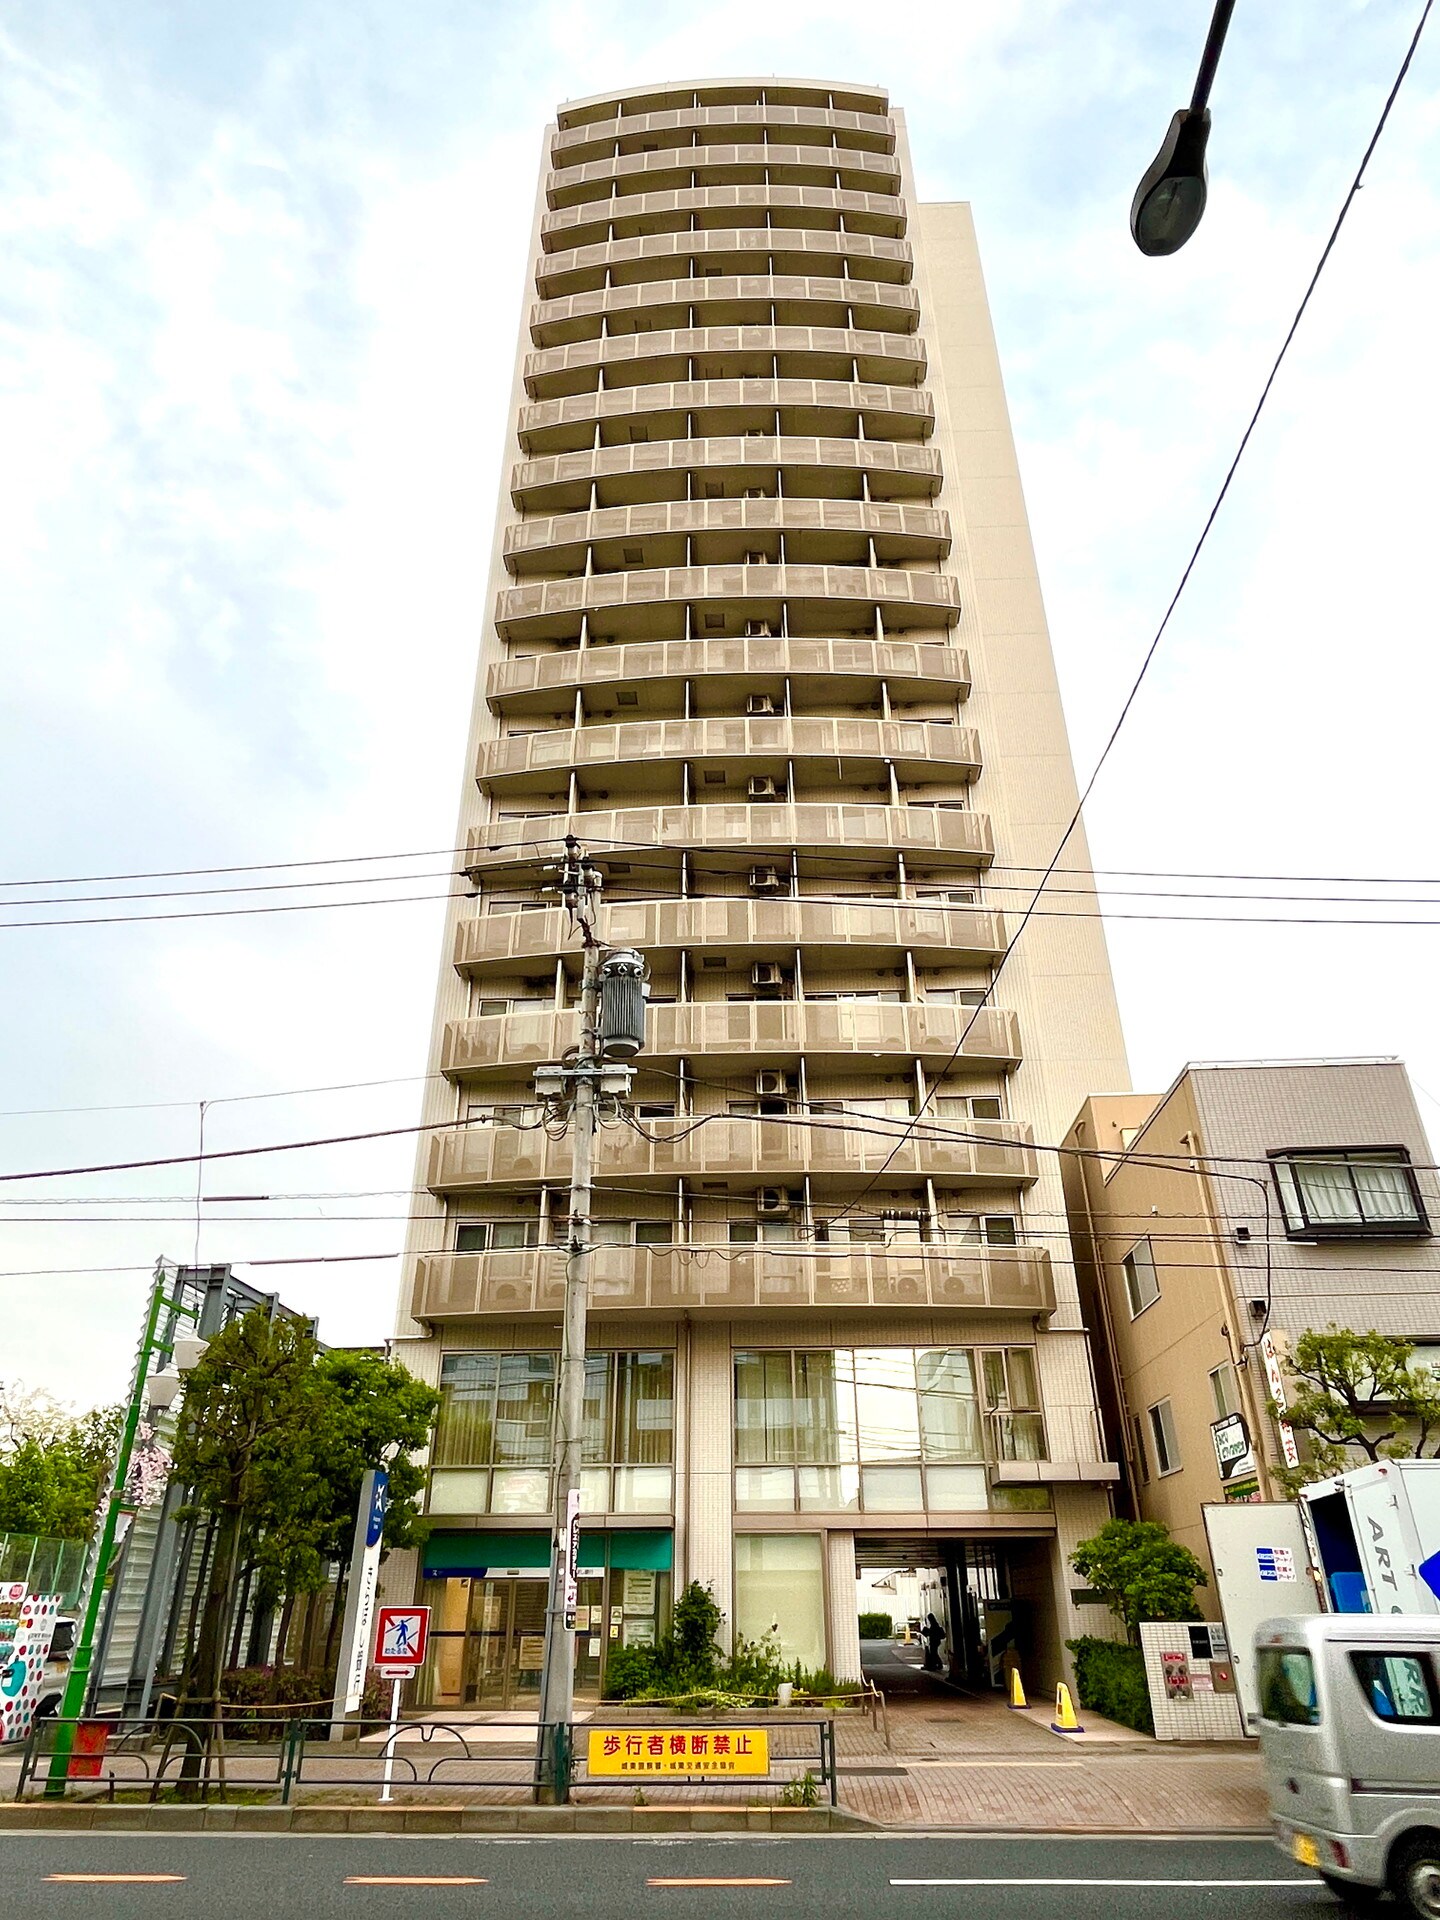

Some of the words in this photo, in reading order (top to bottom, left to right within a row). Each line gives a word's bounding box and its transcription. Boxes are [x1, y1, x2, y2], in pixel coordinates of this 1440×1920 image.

[1368, 1515, 1398, 1591] ART
[603, 1734, 753, 1756] 歩行者横断禁止
